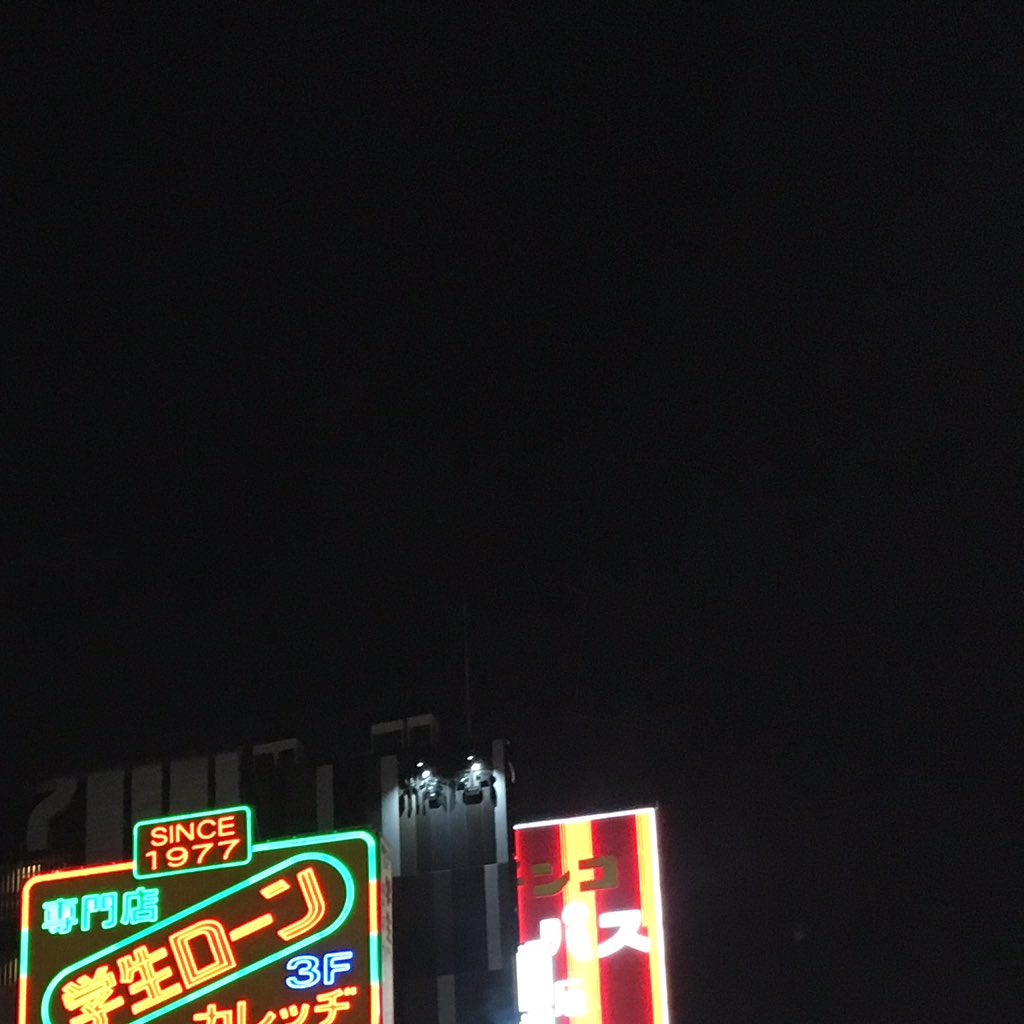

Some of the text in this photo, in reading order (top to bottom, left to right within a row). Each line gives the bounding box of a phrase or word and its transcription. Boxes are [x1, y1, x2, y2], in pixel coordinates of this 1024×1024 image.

[150, 815, 237, 848] SINCE
[144, 838, 241, 871] 1977
[41, 886, 160, 935] 専門店
[284, 950, 354, 990] 3F
